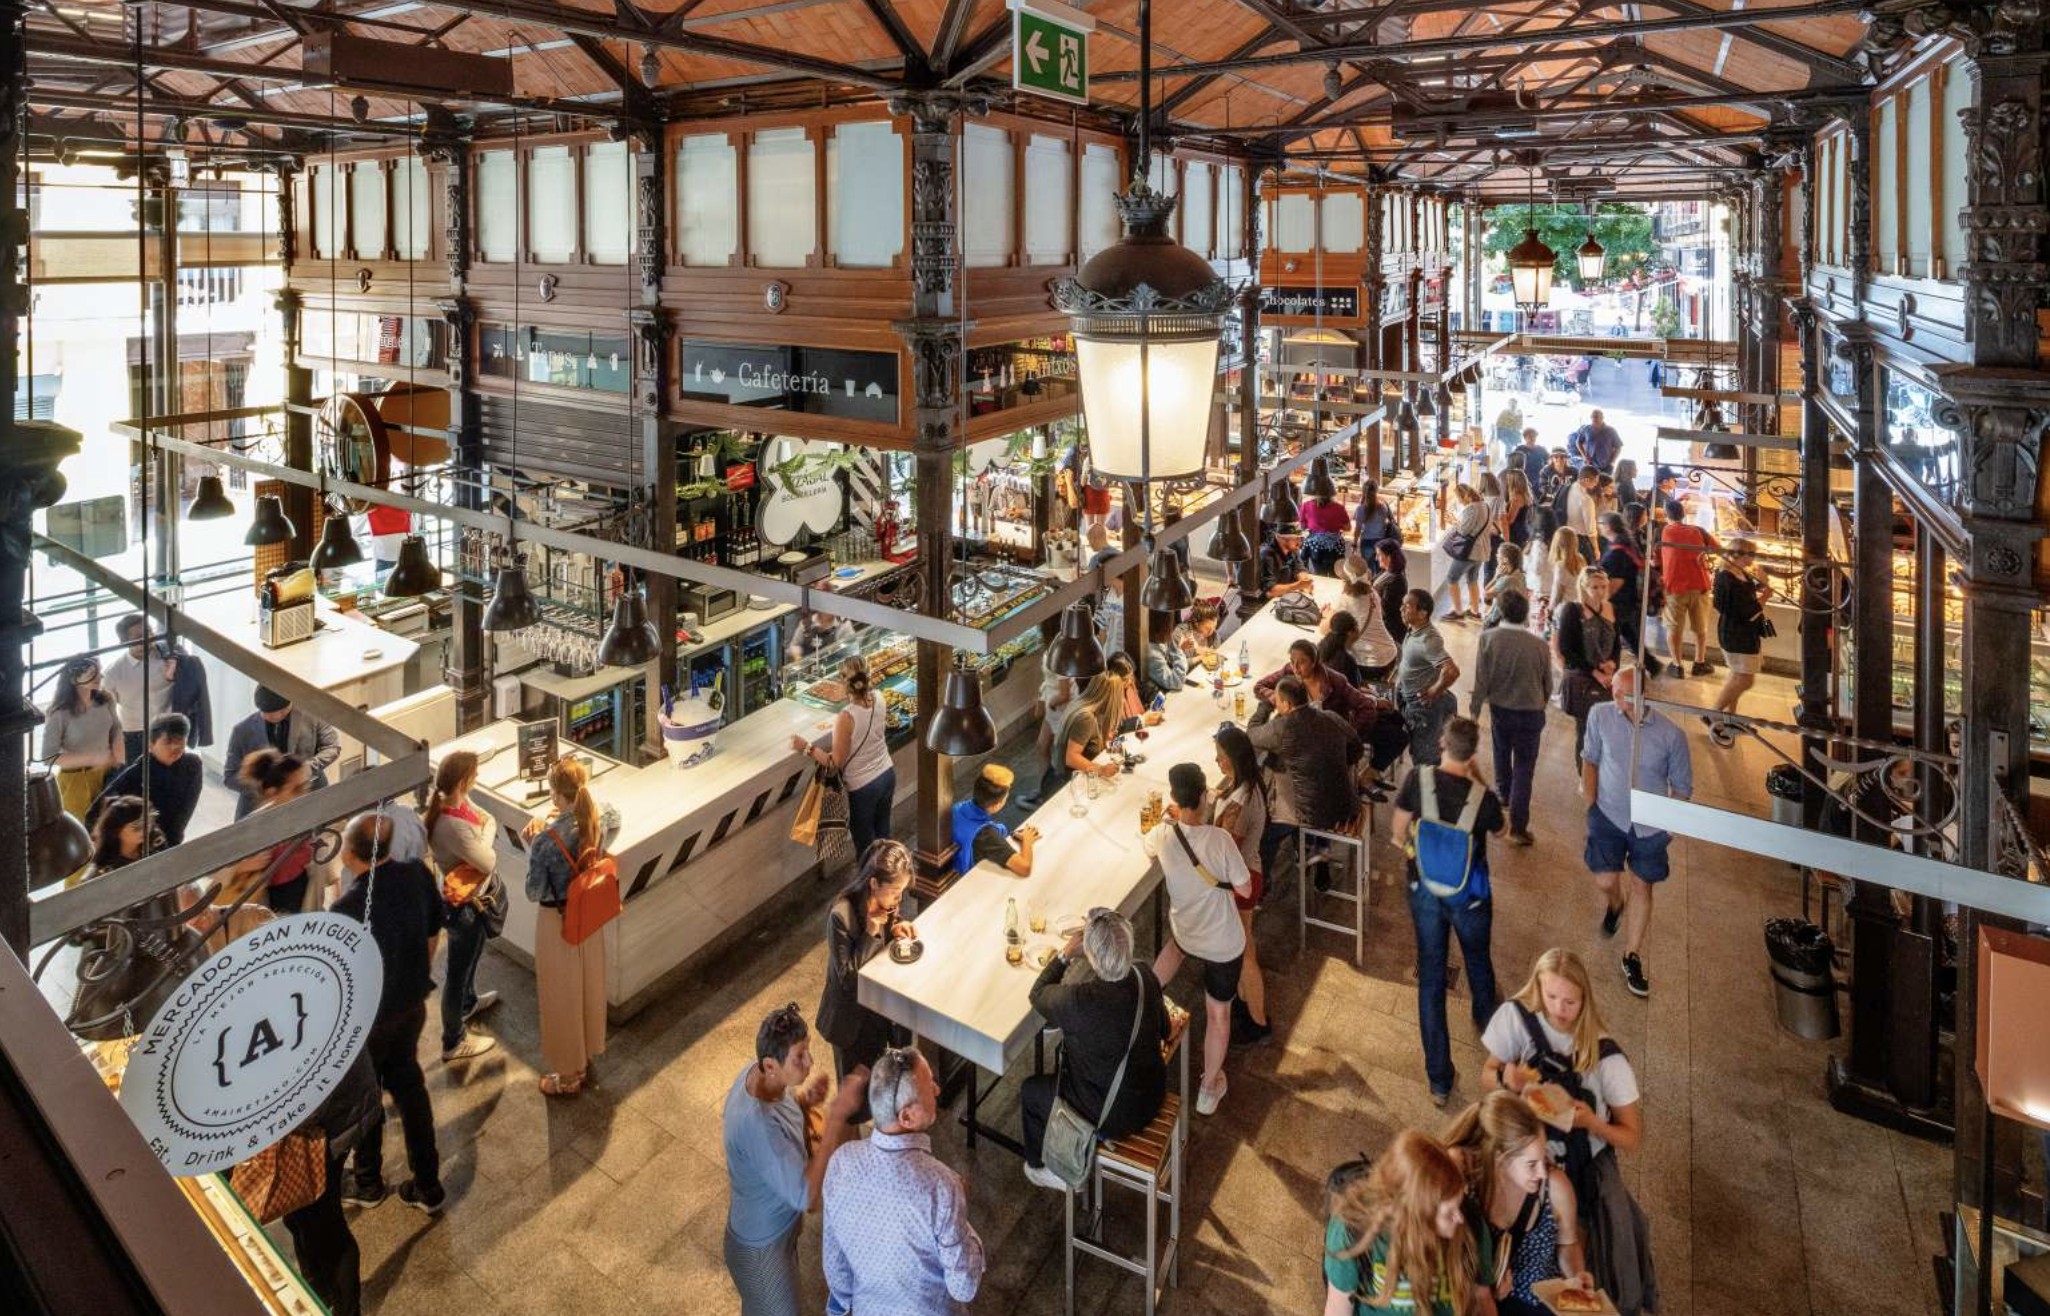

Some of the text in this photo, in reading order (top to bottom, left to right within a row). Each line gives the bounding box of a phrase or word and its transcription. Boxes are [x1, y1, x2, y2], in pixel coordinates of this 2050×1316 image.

[738, 362, 831, 394] Cafetería
[143, 921, 361, 1054] MERCADO SAN MIGUEL
[185, 1146, 236, 1165] Drink
[247, 1134, 260, 1148] &
[266, 1101, 306, 1135] Take
[317, 1077, 331, 1091] it
[332, 1026, 362, 1069] home
